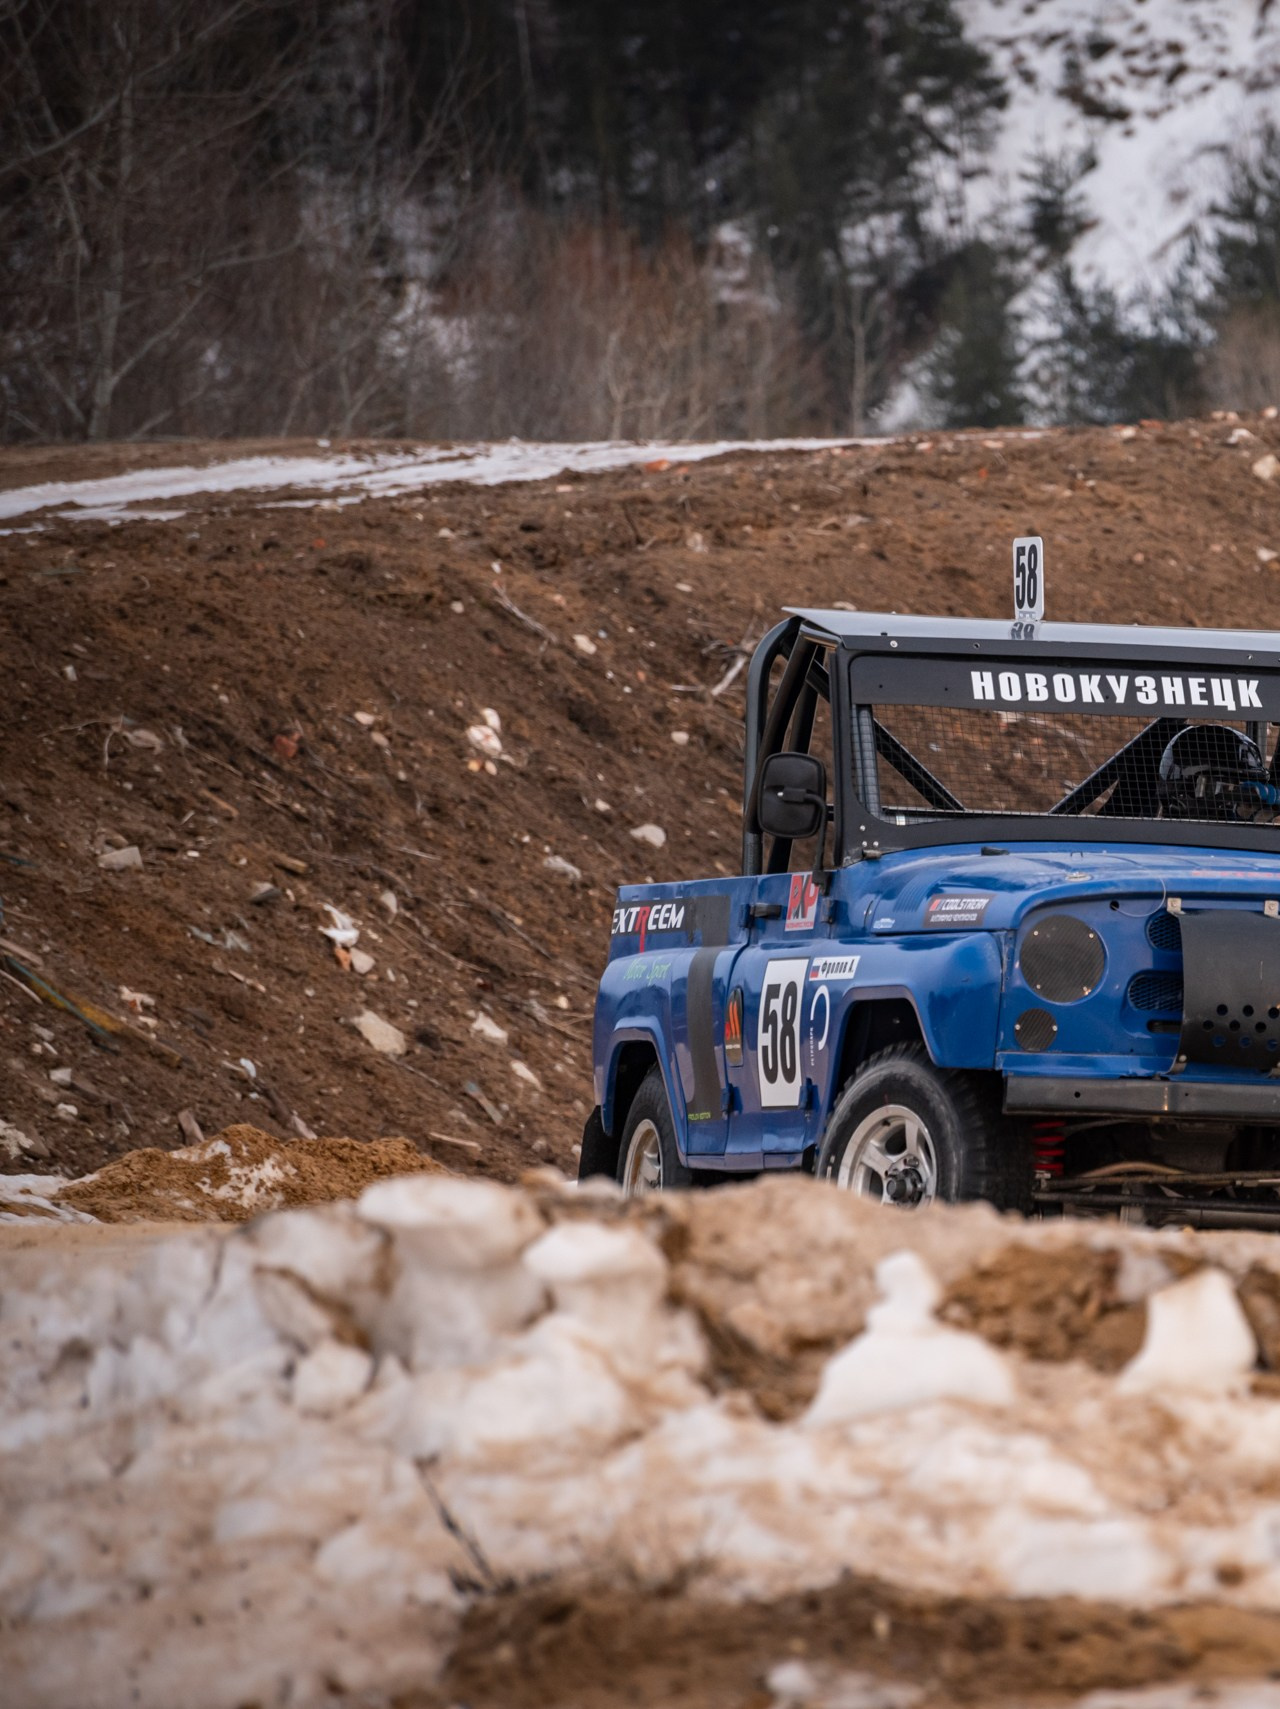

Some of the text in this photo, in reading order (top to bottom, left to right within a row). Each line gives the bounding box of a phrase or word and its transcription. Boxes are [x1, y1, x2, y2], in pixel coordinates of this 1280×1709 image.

[1016, 544, 1037, 609] 58
[971, 671, 1263, 711] НОВОКУЗНЕЦК
[611, 904, 685, 953] EXTREEM
[761, 980, 798, 1085] 58
